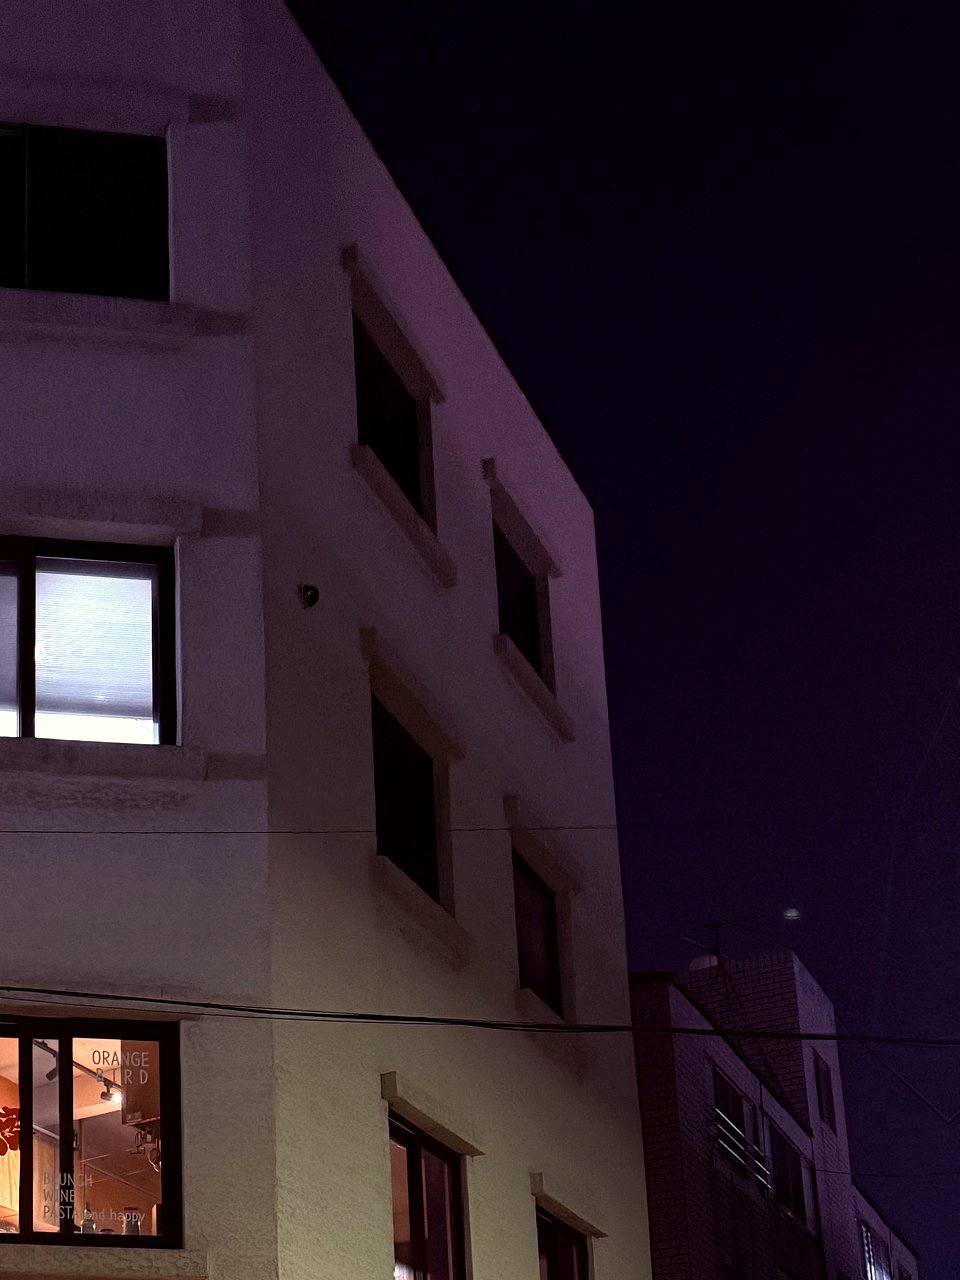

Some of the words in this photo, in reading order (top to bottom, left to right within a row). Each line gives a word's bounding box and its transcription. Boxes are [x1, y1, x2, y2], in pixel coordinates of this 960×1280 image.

[92, 1050, 150, 1067] ORANGE
[96, 1068, 149, 1085] BIRD
[43, 1172, 93, 1187] BUNCH
[110, 1208, 146, 1225] happy
